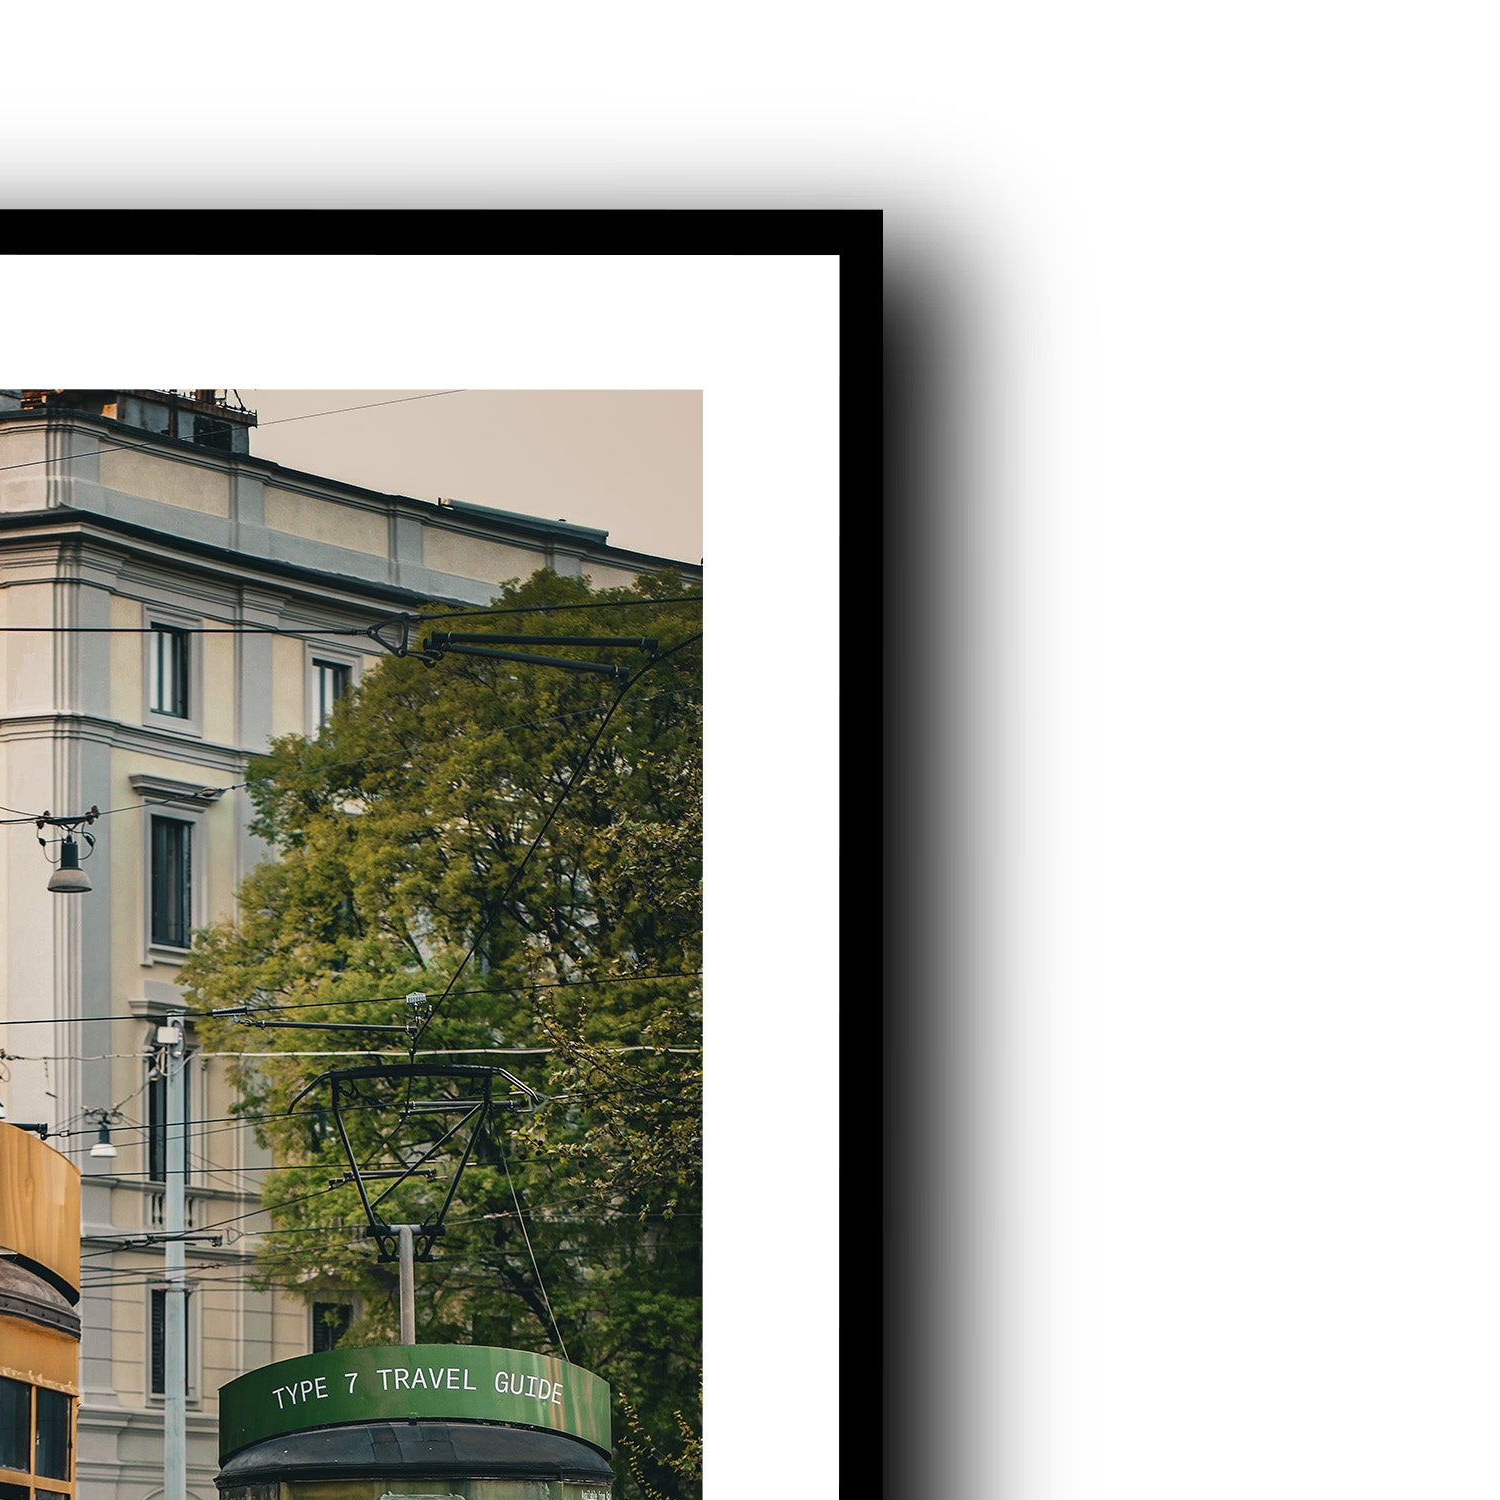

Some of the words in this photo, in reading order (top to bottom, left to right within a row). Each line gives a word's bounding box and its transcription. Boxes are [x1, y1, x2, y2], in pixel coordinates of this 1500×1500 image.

[272, 1376, 329, 1410] TYPE
[344, 1372, 358, 1394] 7
[376, 1367, 477, 1391] TRAVEL
[494, 1371, 564, 1405] GUIDE
